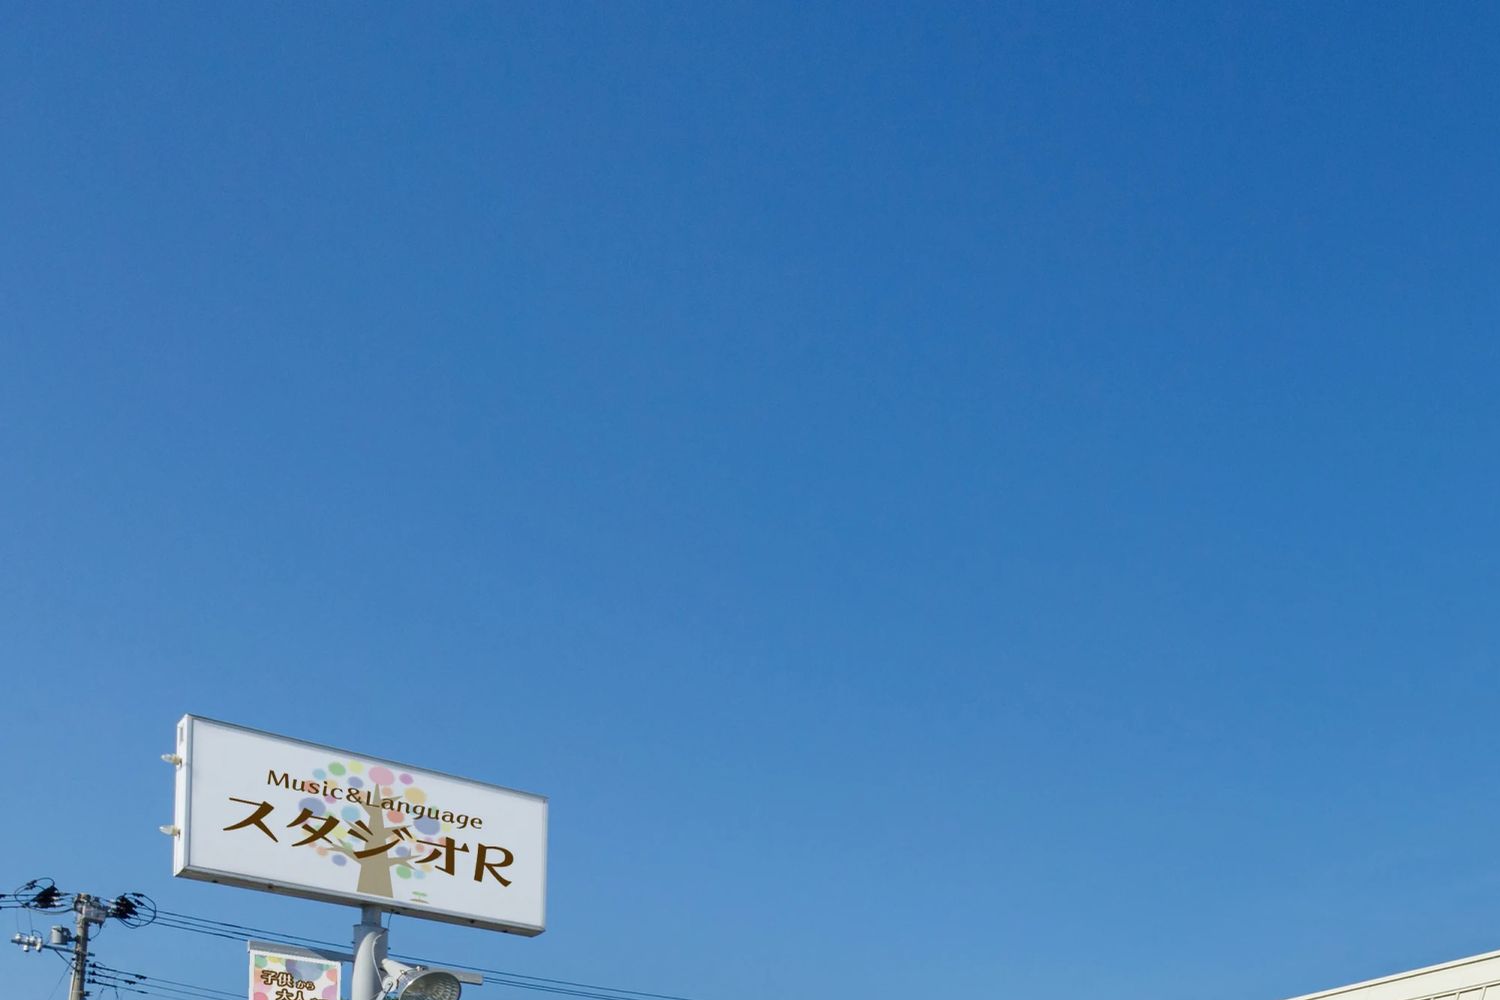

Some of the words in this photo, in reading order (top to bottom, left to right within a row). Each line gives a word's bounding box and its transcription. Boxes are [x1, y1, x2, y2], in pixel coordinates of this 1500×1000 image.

[267, 769, 483, 830] Music&Language
[222, 796, 514, 888] スタジオR
[261, 969, 316, 992] 子供から
